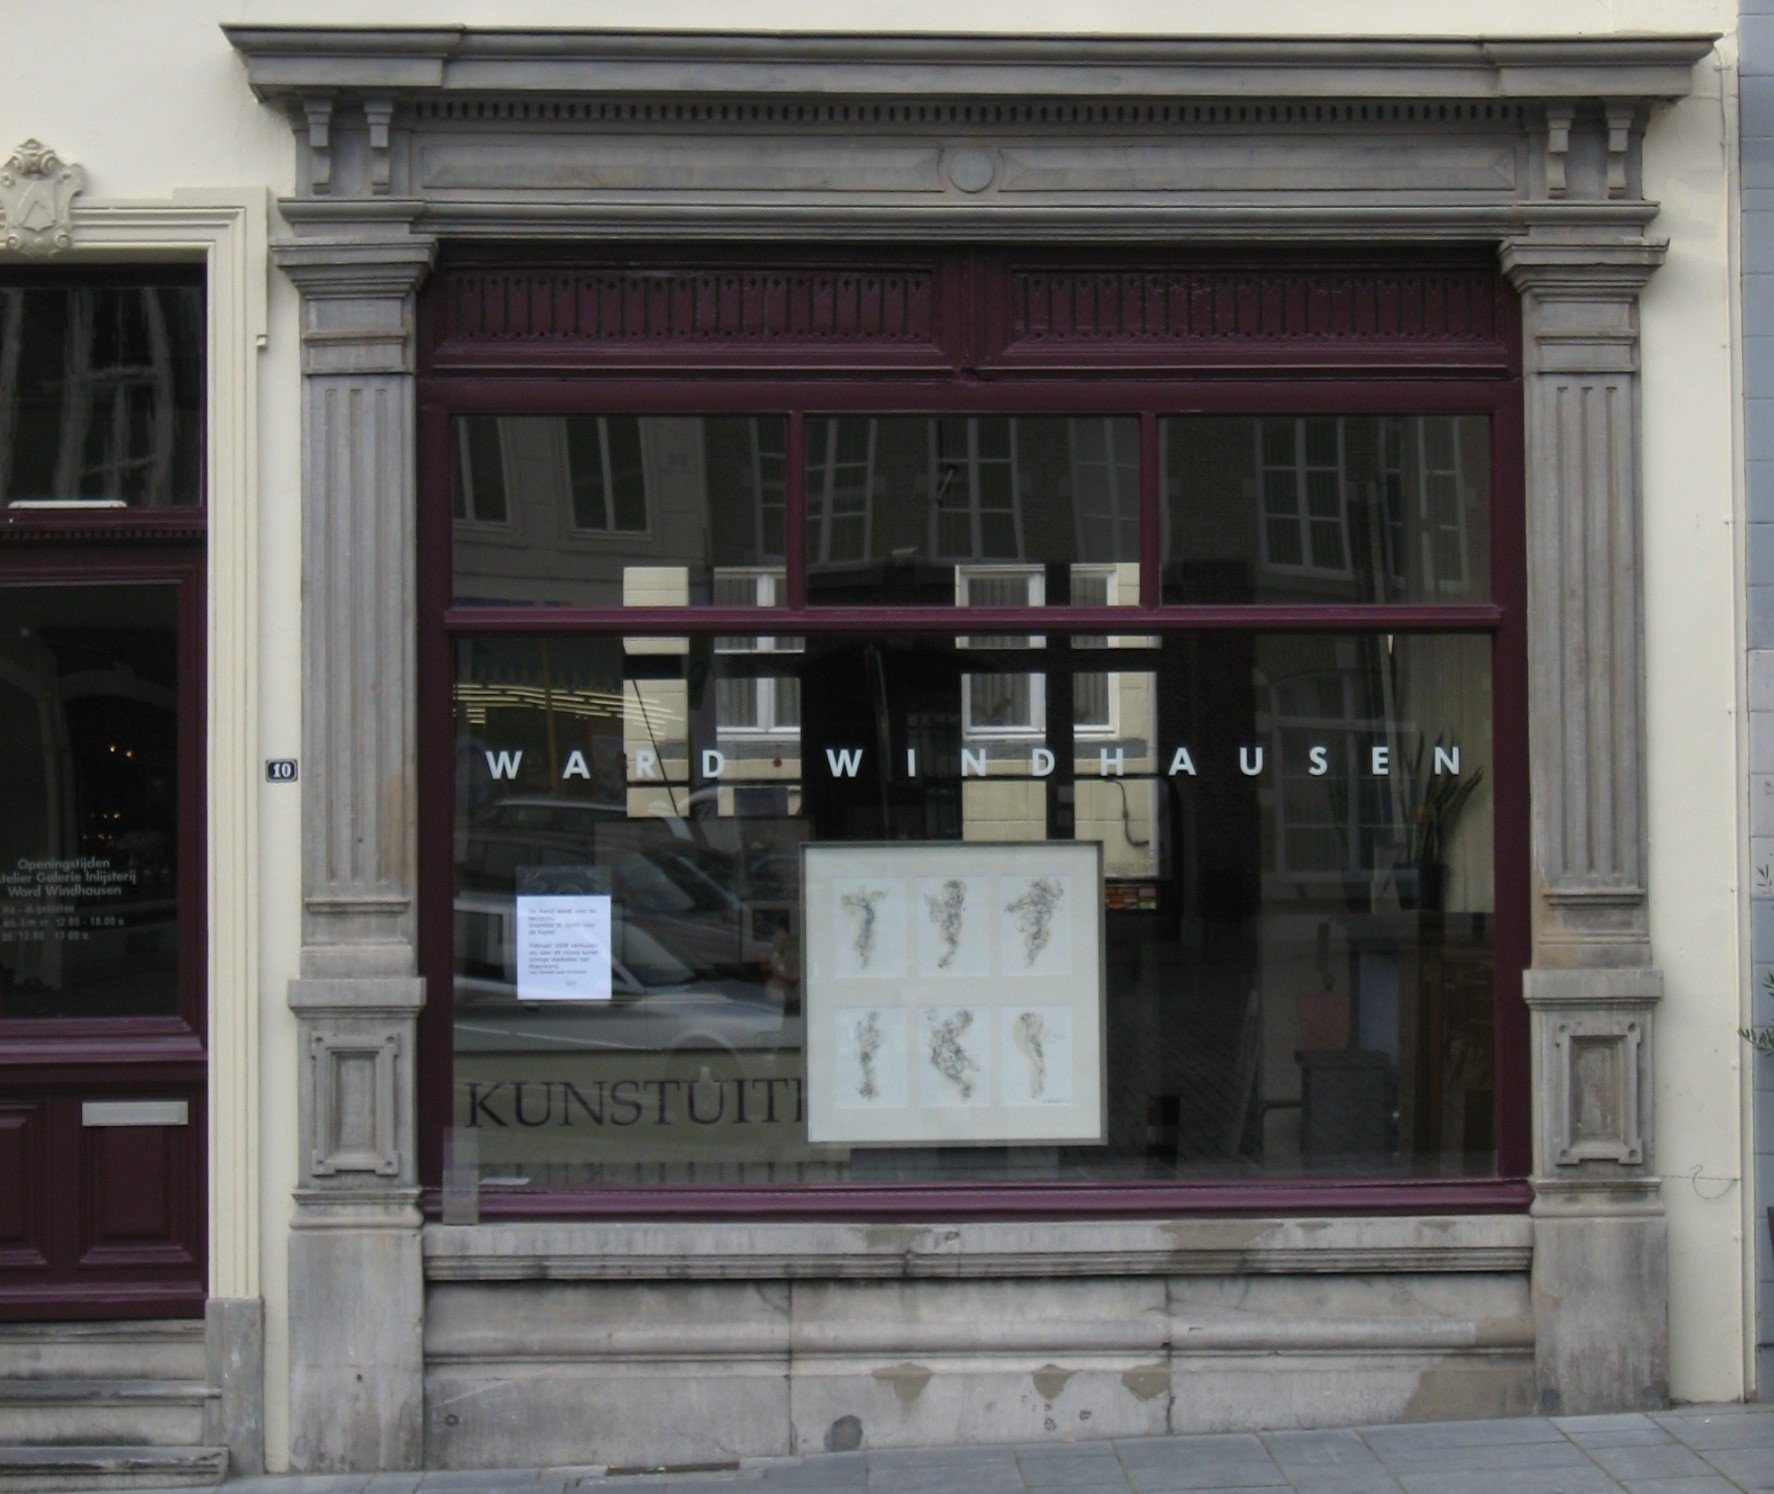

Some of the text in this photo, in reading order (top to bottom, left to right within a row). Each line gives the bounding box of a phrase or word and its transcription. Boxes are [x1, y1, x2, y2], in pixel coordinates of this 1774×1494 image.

[273, 763, 291, 778] 10
[485, 747, 1460, 780] WARD WINDHAUSEN
[18, 858, 110, 872] Openingstijden
[36, 871, 81, 884] Galerie
[85, 870, 137, 885] Inlijsterij
[7, 882, 122, 897] Ward Windhausen
